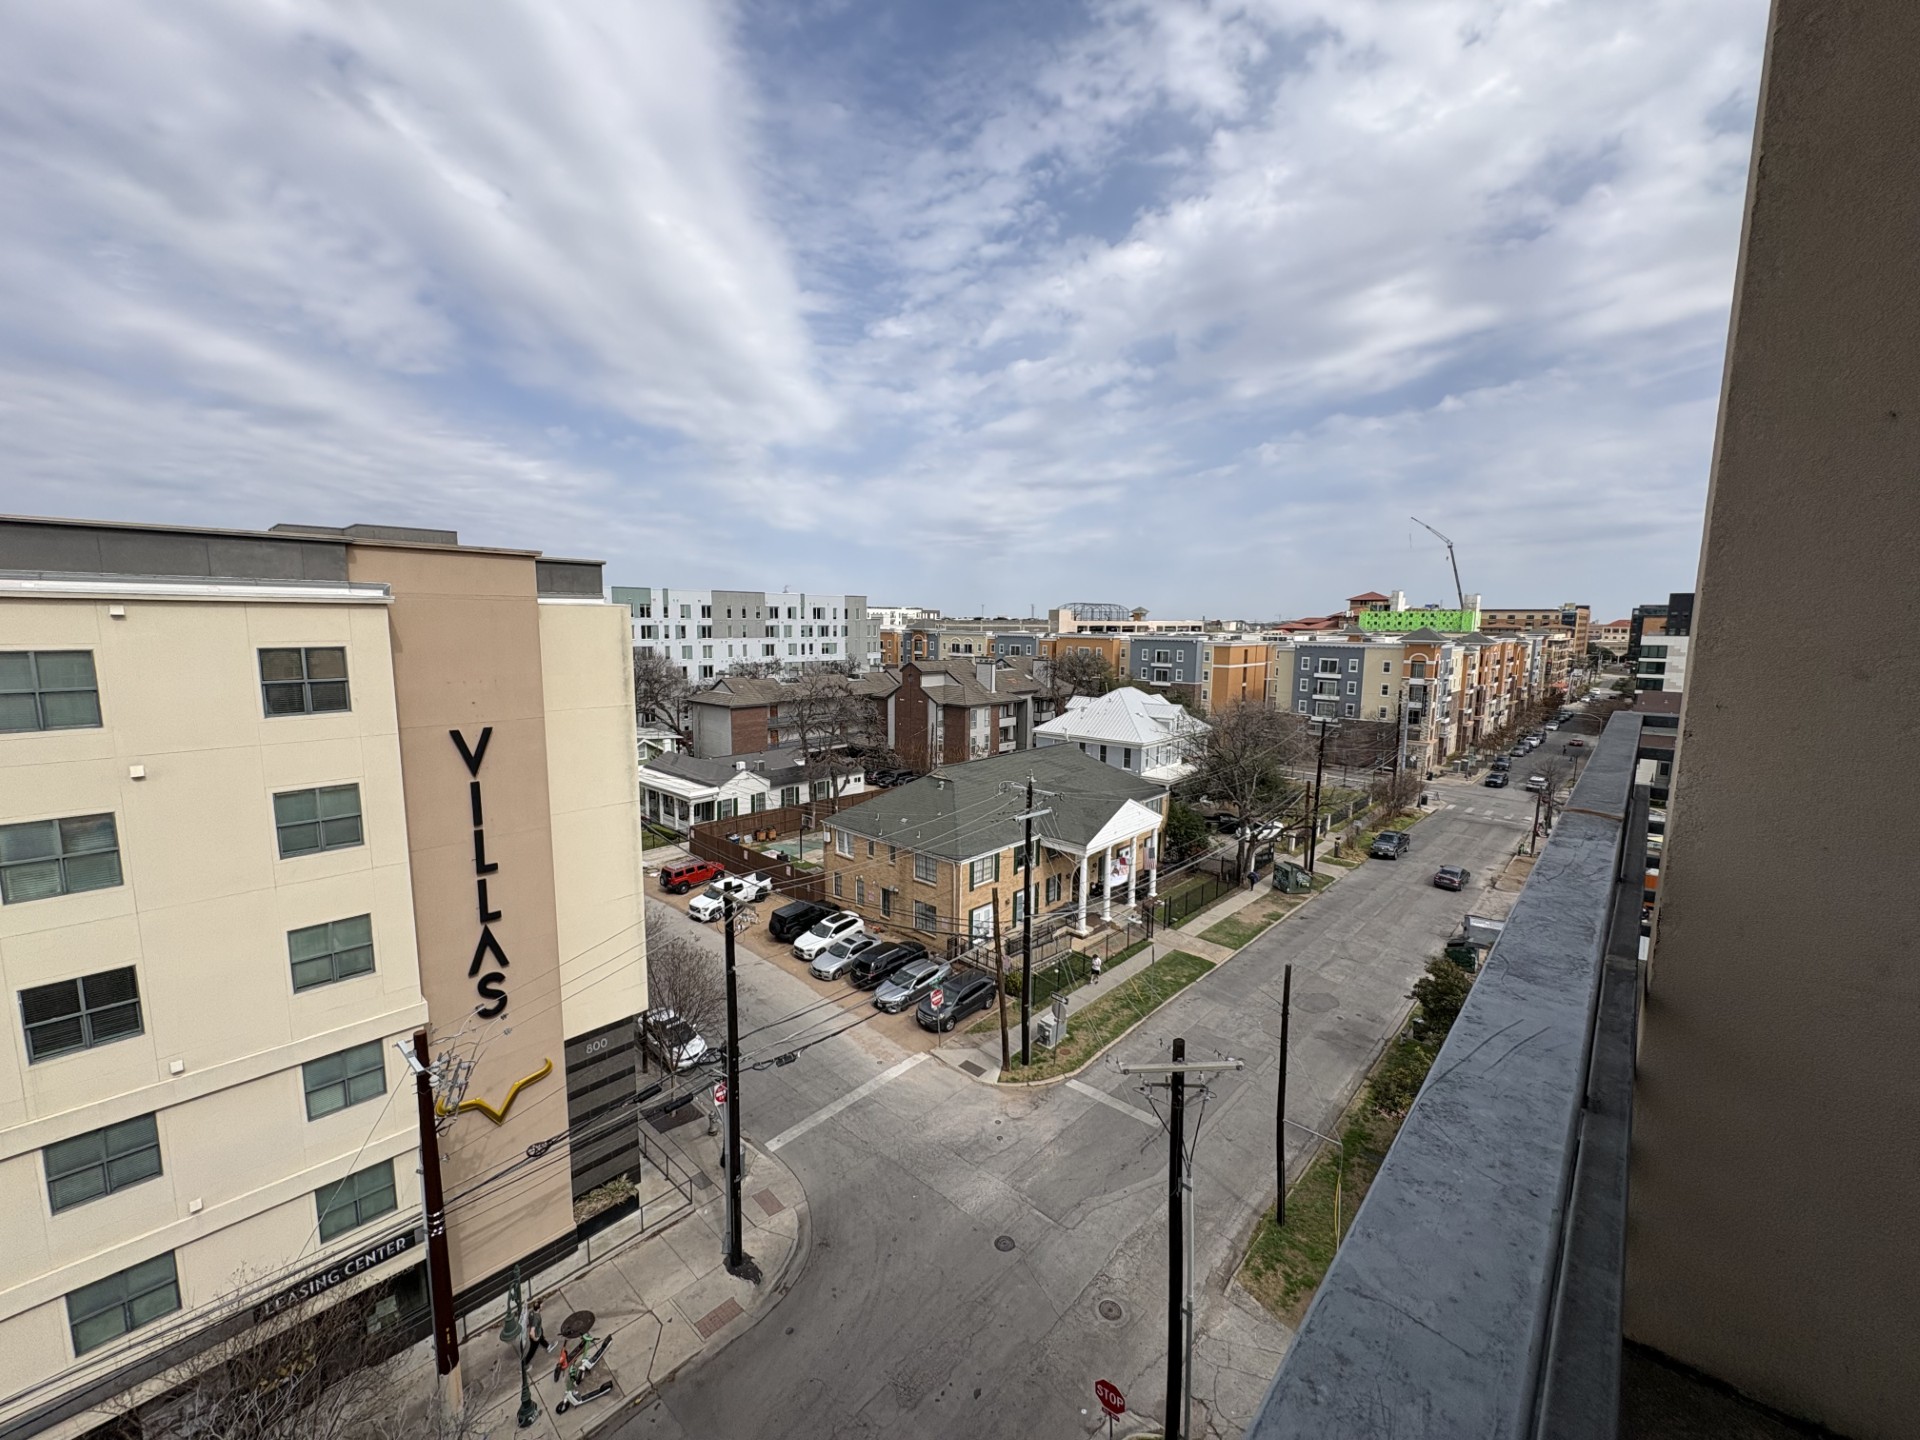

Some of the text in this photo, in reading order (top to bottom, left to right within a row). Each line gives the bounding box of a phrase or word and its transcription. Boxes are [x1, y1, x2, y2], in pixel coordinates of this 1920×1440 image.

[449, 726, 510, 1020] VILLAS
[586, 1038, 608, 1054] 800
[264, 1237, 406, 1316] LEASING CENTER
[1097, 1384, 1123, 1407] STOP
